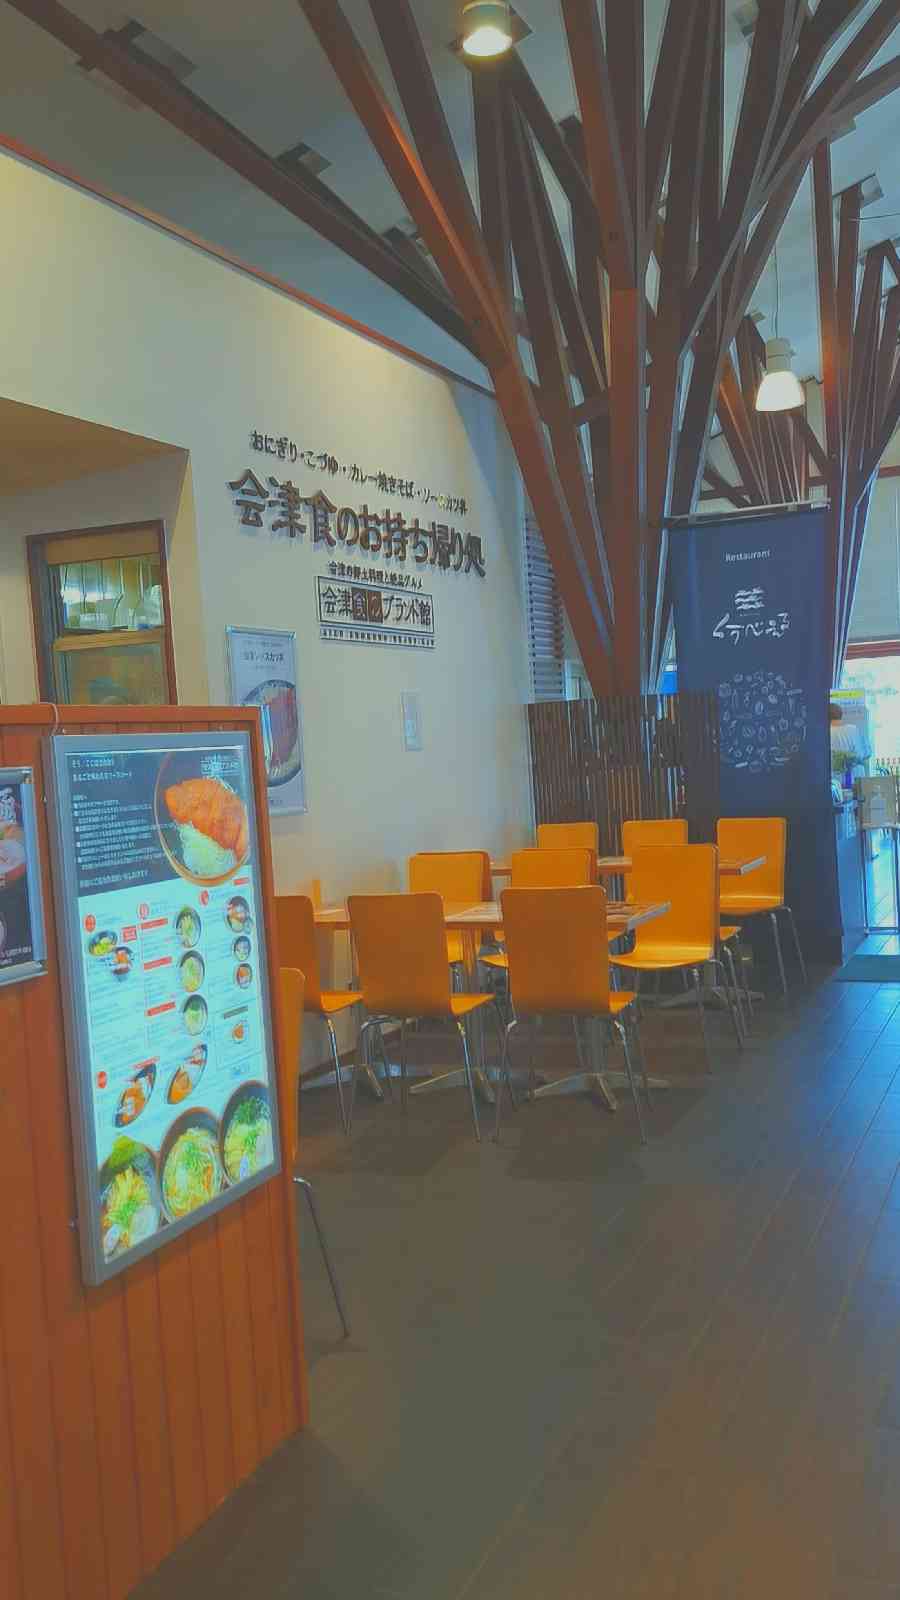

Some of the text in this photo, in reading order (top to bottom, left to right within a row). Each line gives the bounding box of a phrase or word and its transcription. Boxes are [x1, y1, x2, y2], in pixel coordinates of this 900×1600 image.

[228, 468, 486, 578] 会津食のお持ち帰り処
[725, 549, 770, 562] Restaurant
